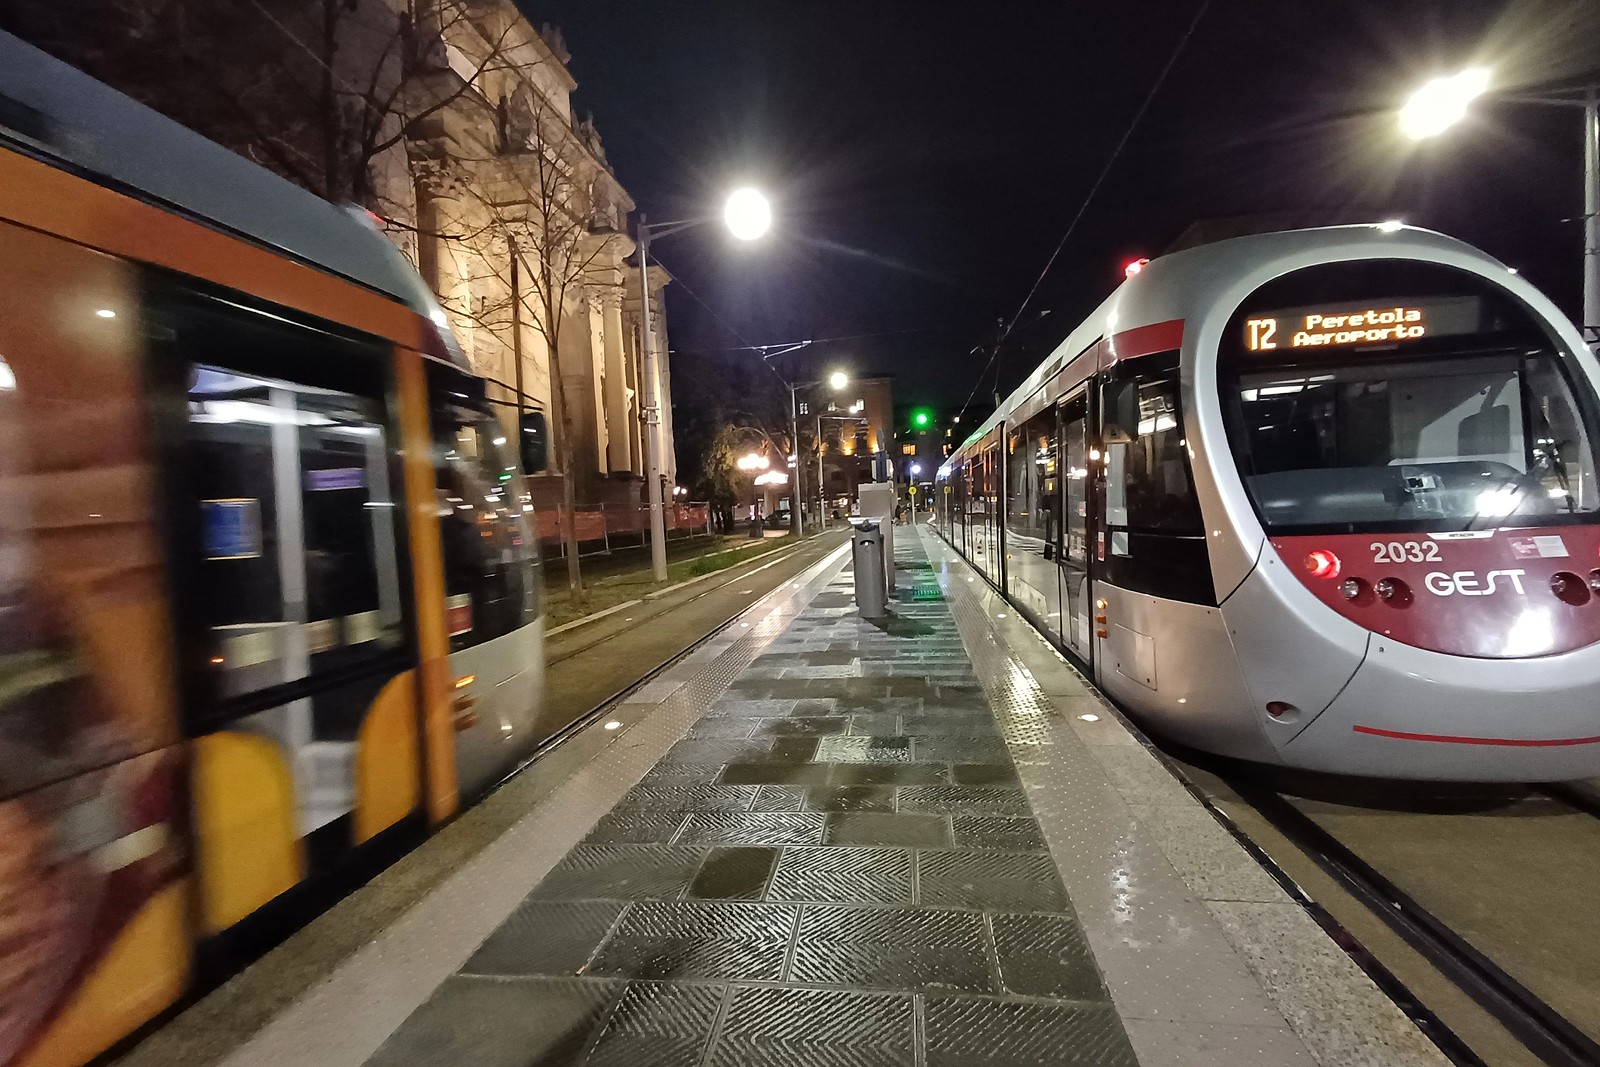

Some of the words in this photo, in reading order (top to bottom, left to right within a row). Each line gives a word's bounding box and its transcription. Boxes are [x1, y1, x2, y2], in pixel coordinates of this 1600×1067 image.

[1306, 308, 1421, 330] Peretola
[1247, 319, 1276, 350] T2
[1293, 324, 1425, 347] Aeroporto
[1370, 541, 1443, 563] 2032
[1425, 569, 1526, 596] GEST
